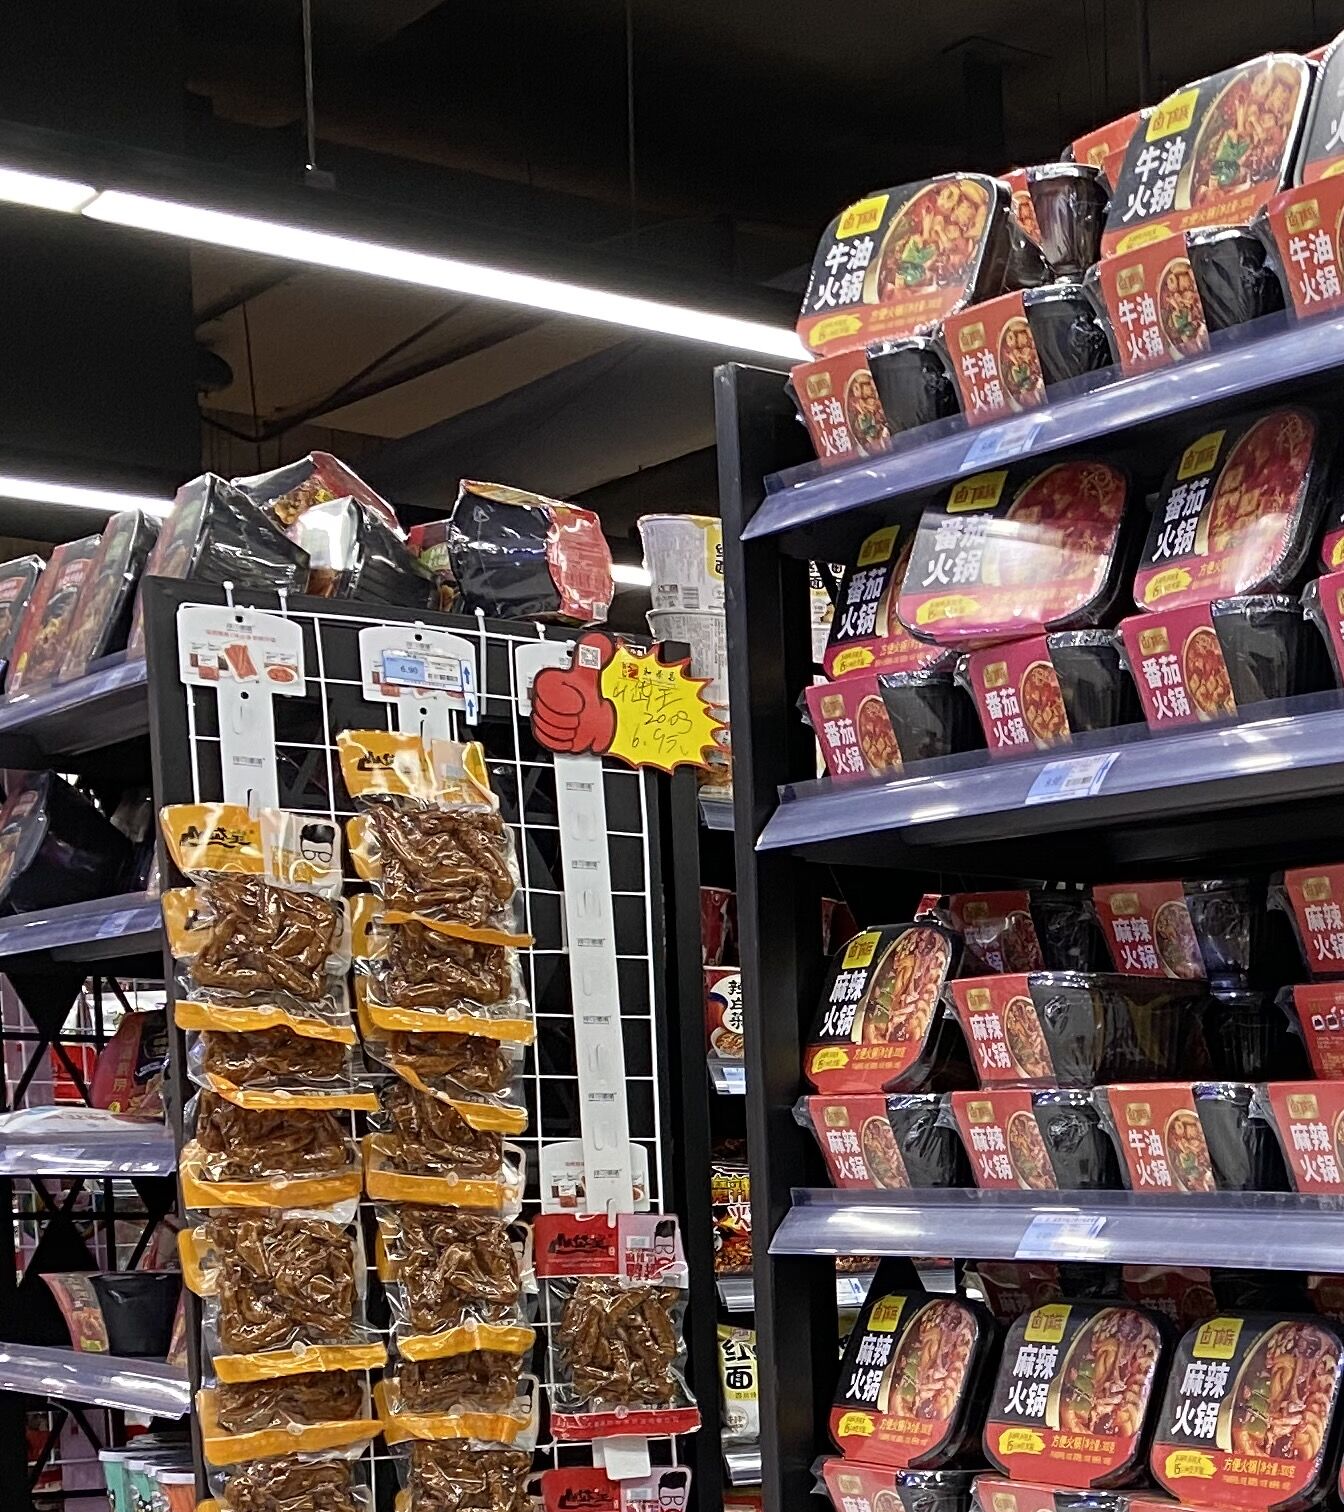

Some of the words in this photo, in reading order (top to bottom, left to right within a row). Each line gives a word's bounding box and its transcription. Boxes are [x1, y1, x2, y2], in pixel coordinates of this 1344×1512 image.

[1134, 136, 1186, 182] 牛油
[1121, 174, 1176, 222] 火锅
[825, 236, 874, 276] 牛油
[1288, 229, 1334, 266] 牛油
[813, 270, 866, 311] 火锅
[1299, 264, 1341, 304] 火锅
[1117, 292, 1156, 330] 牛油
[1127, 326, 1165, 361] 火锅
[962, 348, 996, 383] 牛油
[970, 378, 1004, 414] 火锅
[810, 397, 845, 429] 牛油
[820, 427, 851, 457] 火锅
[1163, 477, 1210, 522] 番茄
[934, 514, 994, 551] 番茄
[1151, 520, 1196, 563] 火锅
[847, 566, 886, 605] 番茄
[922, 551, 982, 587] 火锅
[836, 605, 876, 639] 火锅
[1141, 655, 1182, 690] 番茄
[984, 688, 1020, 721] 番茄
[1151, 688, 1191, 720] 火锅
[823, 719, 856, 748] 番茄
[993, 719, 1030, 748] 火锅
[832, 747, 865, 775] 火锅
[1112, 918, 1152, 943] 麻辣
[1304, 903, 1344, 931] 麻辣
[1120, 944, 1160, 971] 火锅
[828, 970, 869, 1003] 麻辣
[819, 1004, 857, 1037] 火锅
[968, 1014, 1004, 1041] 麻辣
[977, 1042, 1012, 1070] 火锅
[826, 1128, 861, 1154] 麻辣
[969, 1126, 1006, 1153] 麻辣
[1127, 1129, 1165, 1157] 牛油
[1289, 1122, 1332, 1153] 麻辣
[835, 1154, 870, 1181] 火锅
[978, 1154, 1013, 1181] 火锅
[1135, 1159, 1172, 1187] 火锅
[1300, 1154, 1341, 1184] 火锅
[855, 1333, 893, 1366] 麻辣
[1012, 1344, 1057, 1379] 麻辣
[846, 1369, 882, 1403] 火锅
[1179, 1360, 1232, 1399] 麻辣
[1004, 1381, 1049, 1418] 火锅
[1170, 1401, 1220, 1439] 火锅
